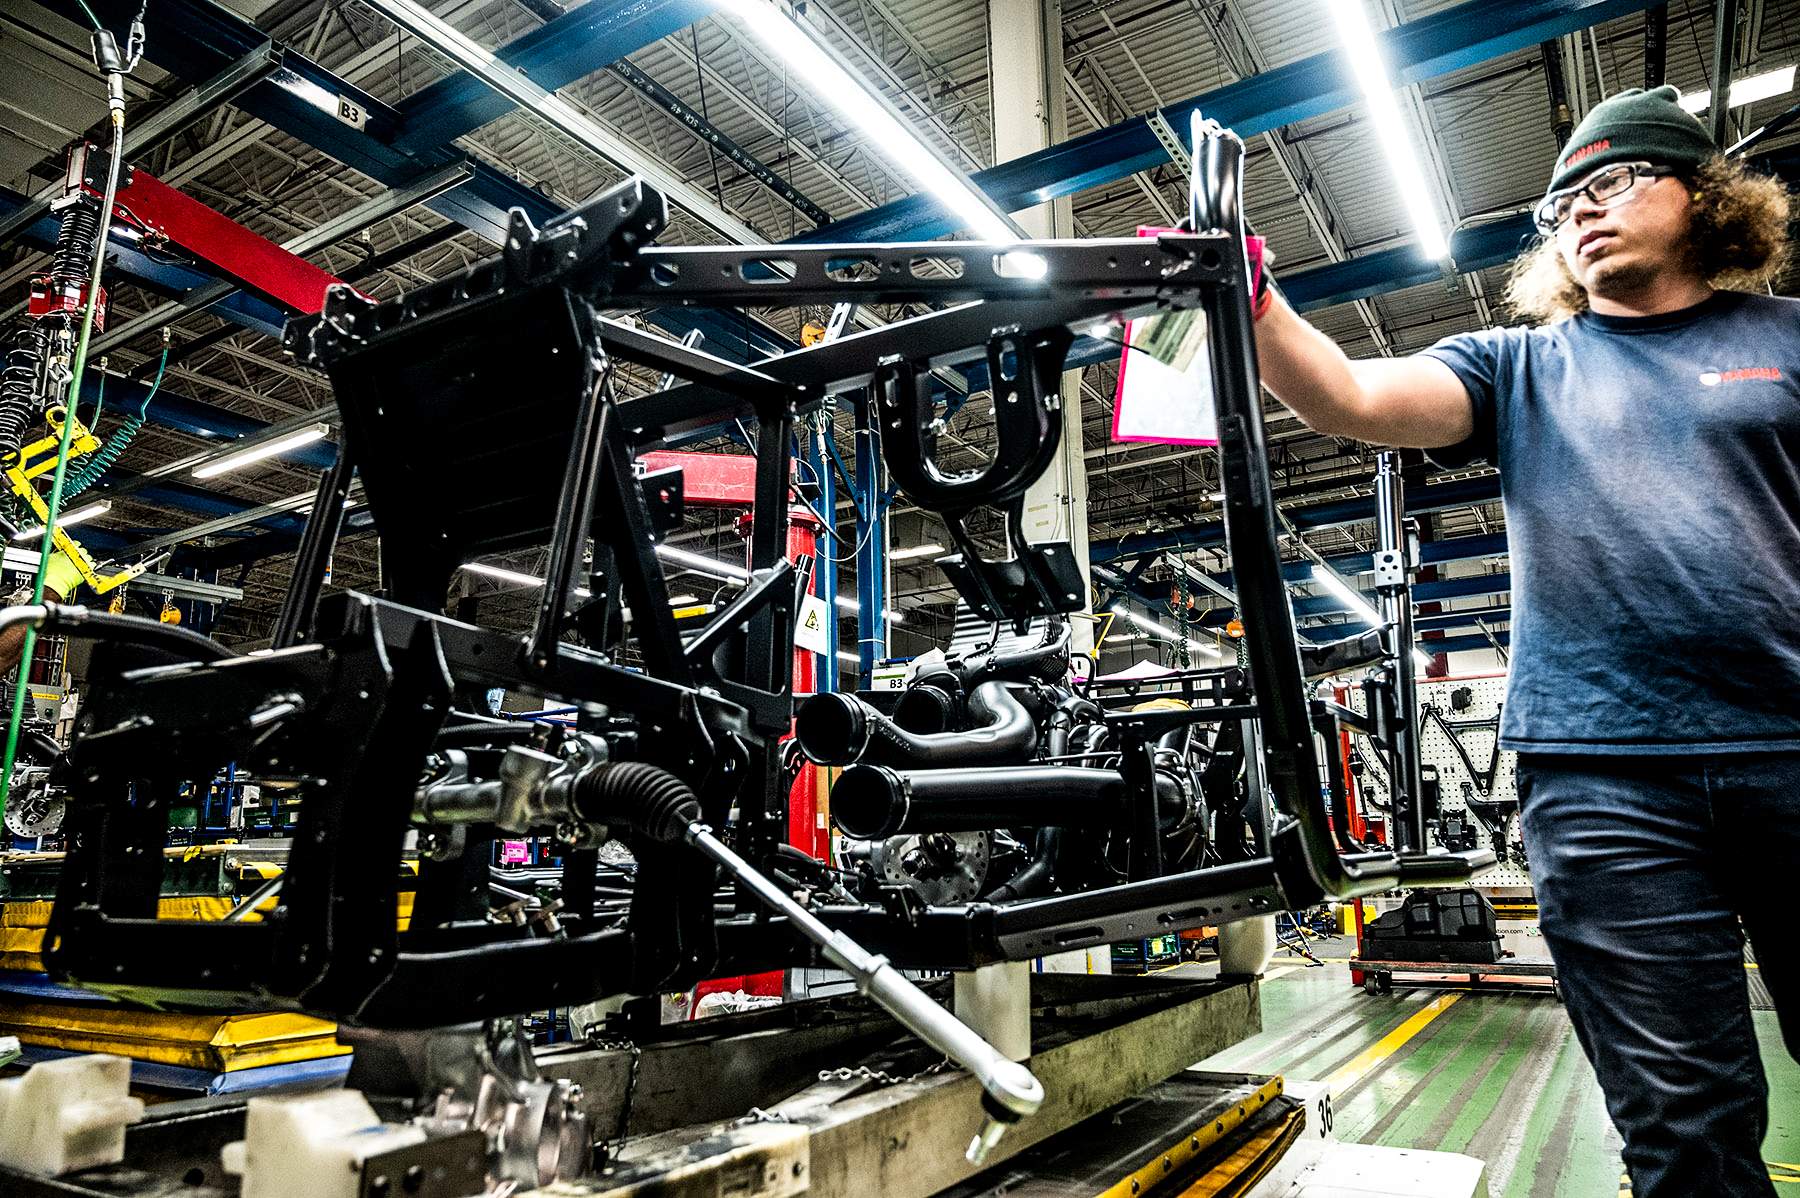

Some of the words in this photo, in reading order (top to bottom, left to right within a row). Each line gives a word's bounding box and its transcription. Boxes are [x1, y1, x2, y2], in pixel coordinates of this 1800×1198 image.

[341, 101, 359, 123] B3
[685, 113, 699, 128] SCH
[1565, 138, 1611, 169] YAMAHA
[890, 679, 903, 688] B3
[1317, 1094, 1333, 1139] 36
